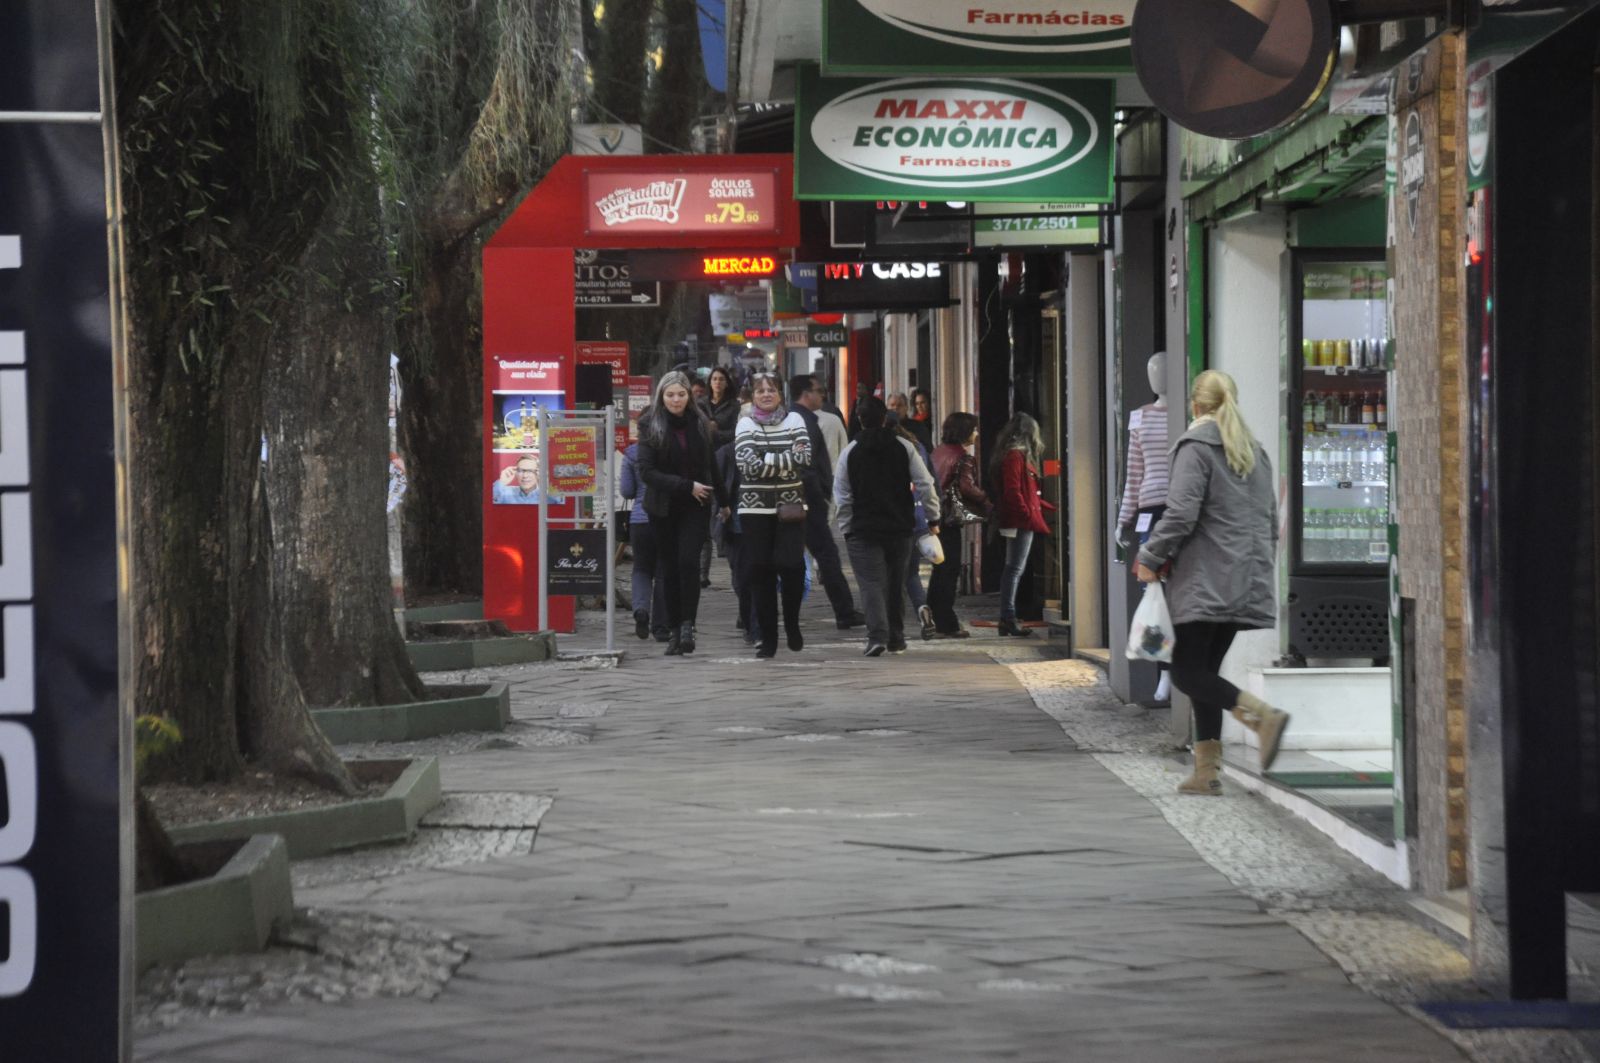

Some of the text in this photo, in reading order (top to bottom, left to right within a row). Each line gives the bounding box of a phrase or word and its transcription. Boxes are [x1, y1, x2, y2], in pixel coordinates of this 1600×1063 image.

[967, 9, 1125, 26] Farmácias
[874, 99, 1027, 120] MAXXI
[853, 120, 1058, 149] ECONÔMICA
[899, 155, 1012, 168] Farmácias
[711, 177, 752, 188] ÓCULOS
[709, 188, 755, 199] SOLARES
[992, 216, 1078, 231] 3717.2501
[703, 257, 775, 275] MERCAD
[872, 262, 941, 279] CASE
